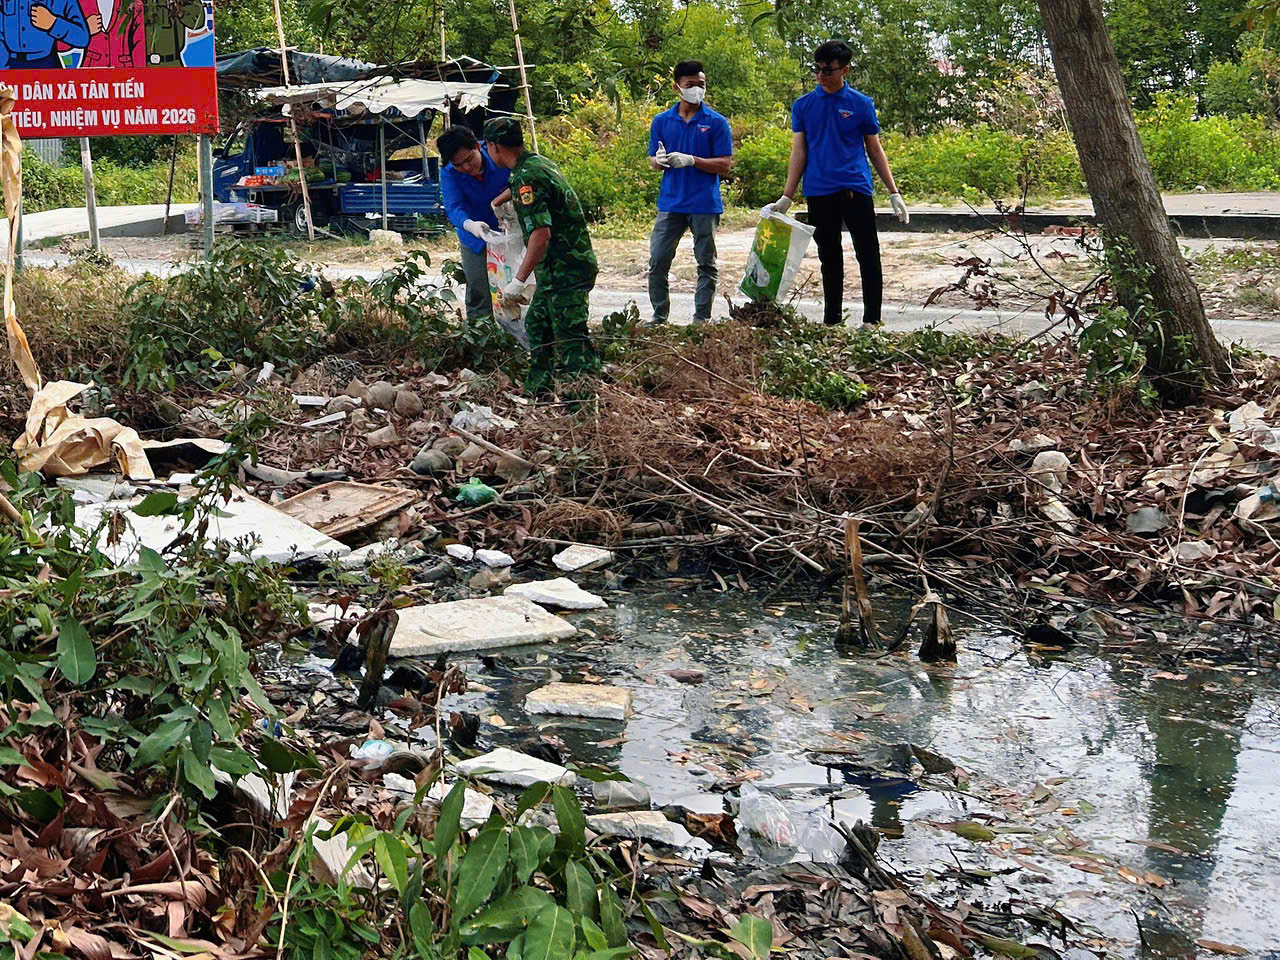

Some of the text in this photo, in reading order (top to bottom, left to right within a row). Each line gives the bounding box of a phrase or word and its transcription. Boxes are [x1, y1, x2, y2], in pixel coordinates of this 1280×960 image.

[23, 79, 53, 101] DÂN
[57, 79, 77, 100] XÃ
[80, 79, 110, 100] TÂN
[112, 76, 145, 98] TIẾN
[50, 107, 98, 130] NHIỆM
[101, 110, 121, 129] VỤ
[124, 106, 158, 126] NĂM
[161, 107, 197, 125] 2026
